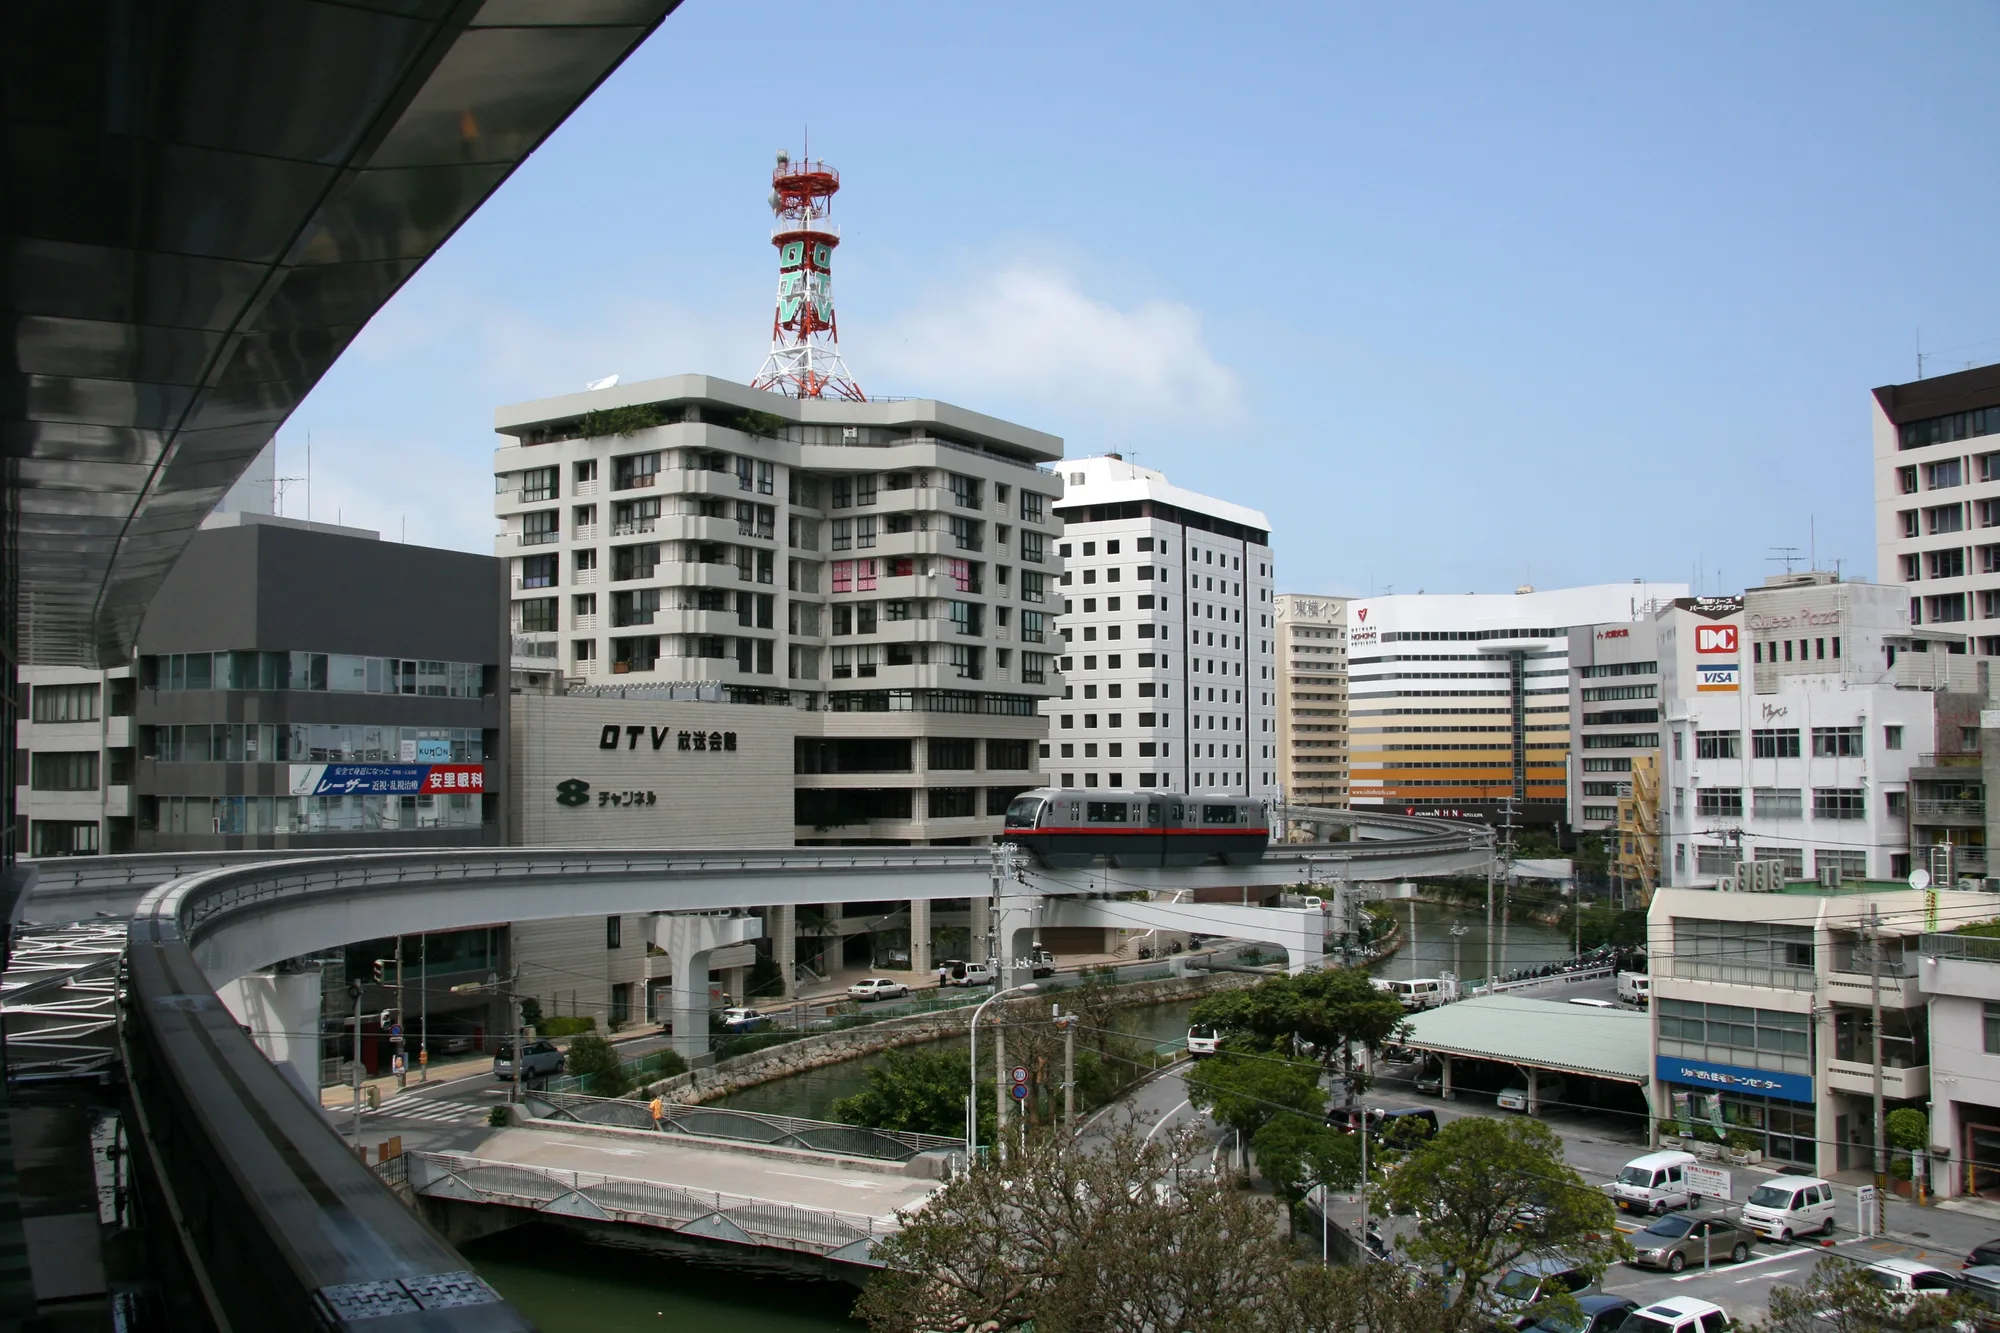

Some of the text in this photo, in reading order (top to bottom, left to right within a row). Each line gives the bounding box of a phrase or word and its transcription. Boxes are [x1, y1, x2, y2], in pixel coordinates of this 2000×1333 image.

[780, 241, 804, 322] OTV
[813, 242, 833, 322] OTV
[1294, 599, 1341, 619] 東横イン
[1749, 607, 1840, 630] Queen Plaza
[1700, 629, 1734, 650] DC
[1704, 673, 1732, 683] VISA
[600, 725, 737, 751] OTV 放送会館
[419, 747, 448, 756] KUMON
[334, 767, 390, 776] 安全で身近になった
[430, 772, 483, 789] 安里眼科
[317, 779, 418, 794] レーザー 近視・乱視治療
[599, 790, 657, 808] チャンネル
